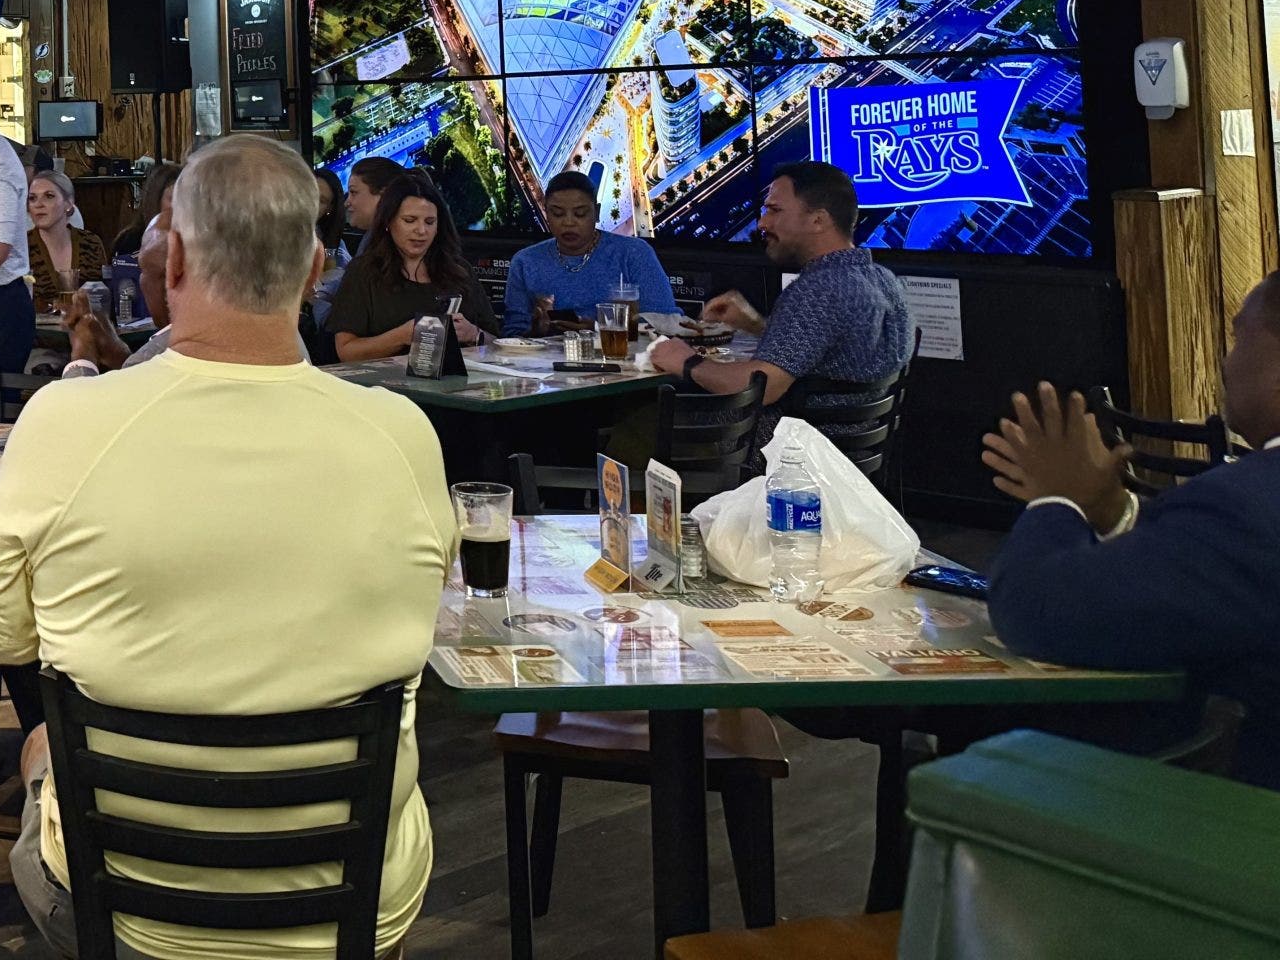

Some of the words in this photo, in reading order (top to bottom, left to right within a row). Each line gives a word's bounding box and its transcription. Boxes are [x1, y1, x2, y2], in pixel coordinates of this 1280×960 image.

[233, 27, 264, 50] FRIED
[237, 53, 277, 74] PICKLES
[850, 97, 923, 126] FOREVER
[927, 90, 978, 118] HOME
[913, 123, 927, 133] OF
[932, 119, 954, 130] THE
[851, 128, 983, 192] RAYS
[493, 259, 510, 268] 202
[867, 649, 980, 658] ITALIANO
